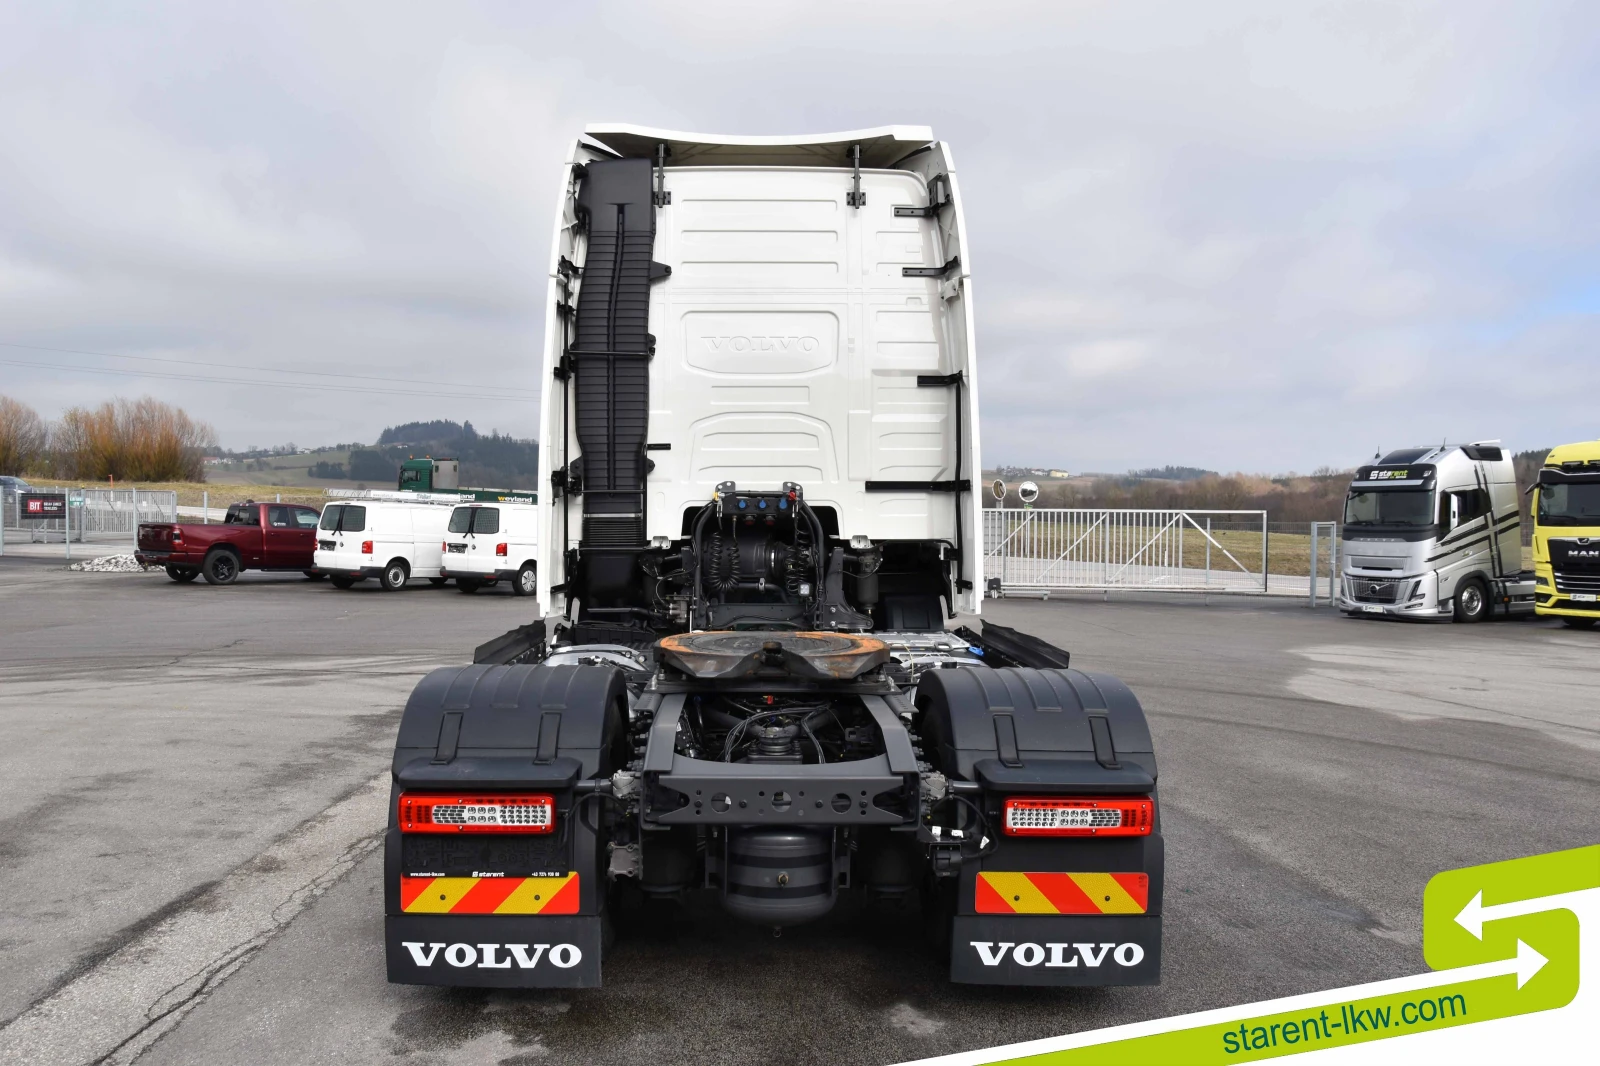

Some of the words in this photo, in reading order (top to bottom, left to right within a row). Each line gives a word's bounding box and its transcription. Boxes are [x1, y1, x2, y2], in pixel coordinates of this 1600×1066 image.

[700, 335, 820, 354] VOLVO
[1567, 550, 1600, 558] MAN
[401, 941, 583, 969] VOLVO
[969, 941, 1145, 968] VOLVO
